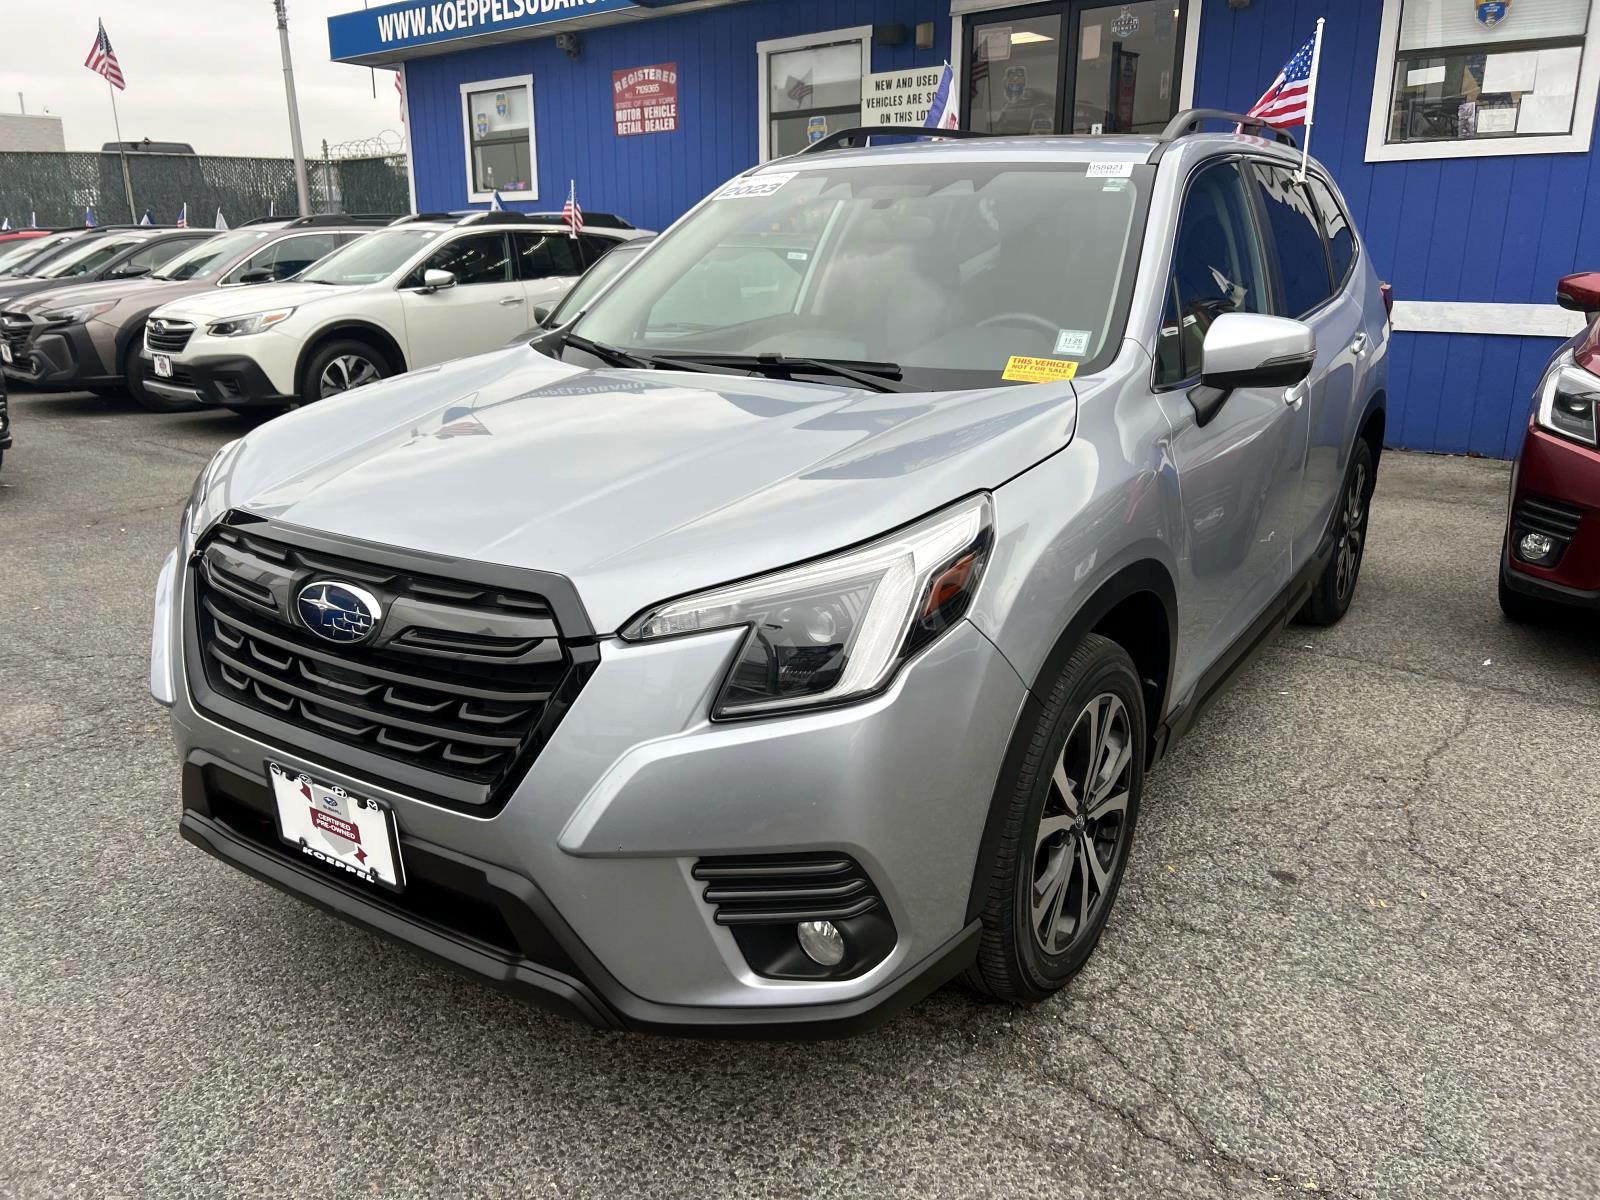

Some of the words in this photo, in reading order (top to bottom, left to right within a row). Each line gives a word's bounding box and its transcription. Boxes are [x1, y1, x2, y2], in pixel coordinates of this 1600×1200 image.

[377, 0, 601, 43] WWW.KOEPPELSUB
[614, 68, 677, 93] REGISTERED
[875, 80, 893, 91] NEW
[896, 78, 913, 89] AND
[916, 74, 938, 87] USED
[866, 95, 903, 109] VEHICLES
[906, 93, 922, 105] ARE
[616, 108, 641, 122] MOTOR
[644, 105, 676, 119] VEHICLE
[880, 113, 891, 124] ON
[894, 111, 913, 123] THIS
[916, 109, 930, 121] LOT
[618, 121, 643, 135] RETAIL
[645, 118, 675, 132] DEALER
[719, 183, 783, 197] 2023
[1012, 357, 1033, 365] THIS
[1035, 359, 1074, 369] VEHICLE
[316, 818, 356, 840] PRE-OWNED
[317, 813, 351, 831] CERTIFIED
[302, 846, 375, 883] KOEPPEL
